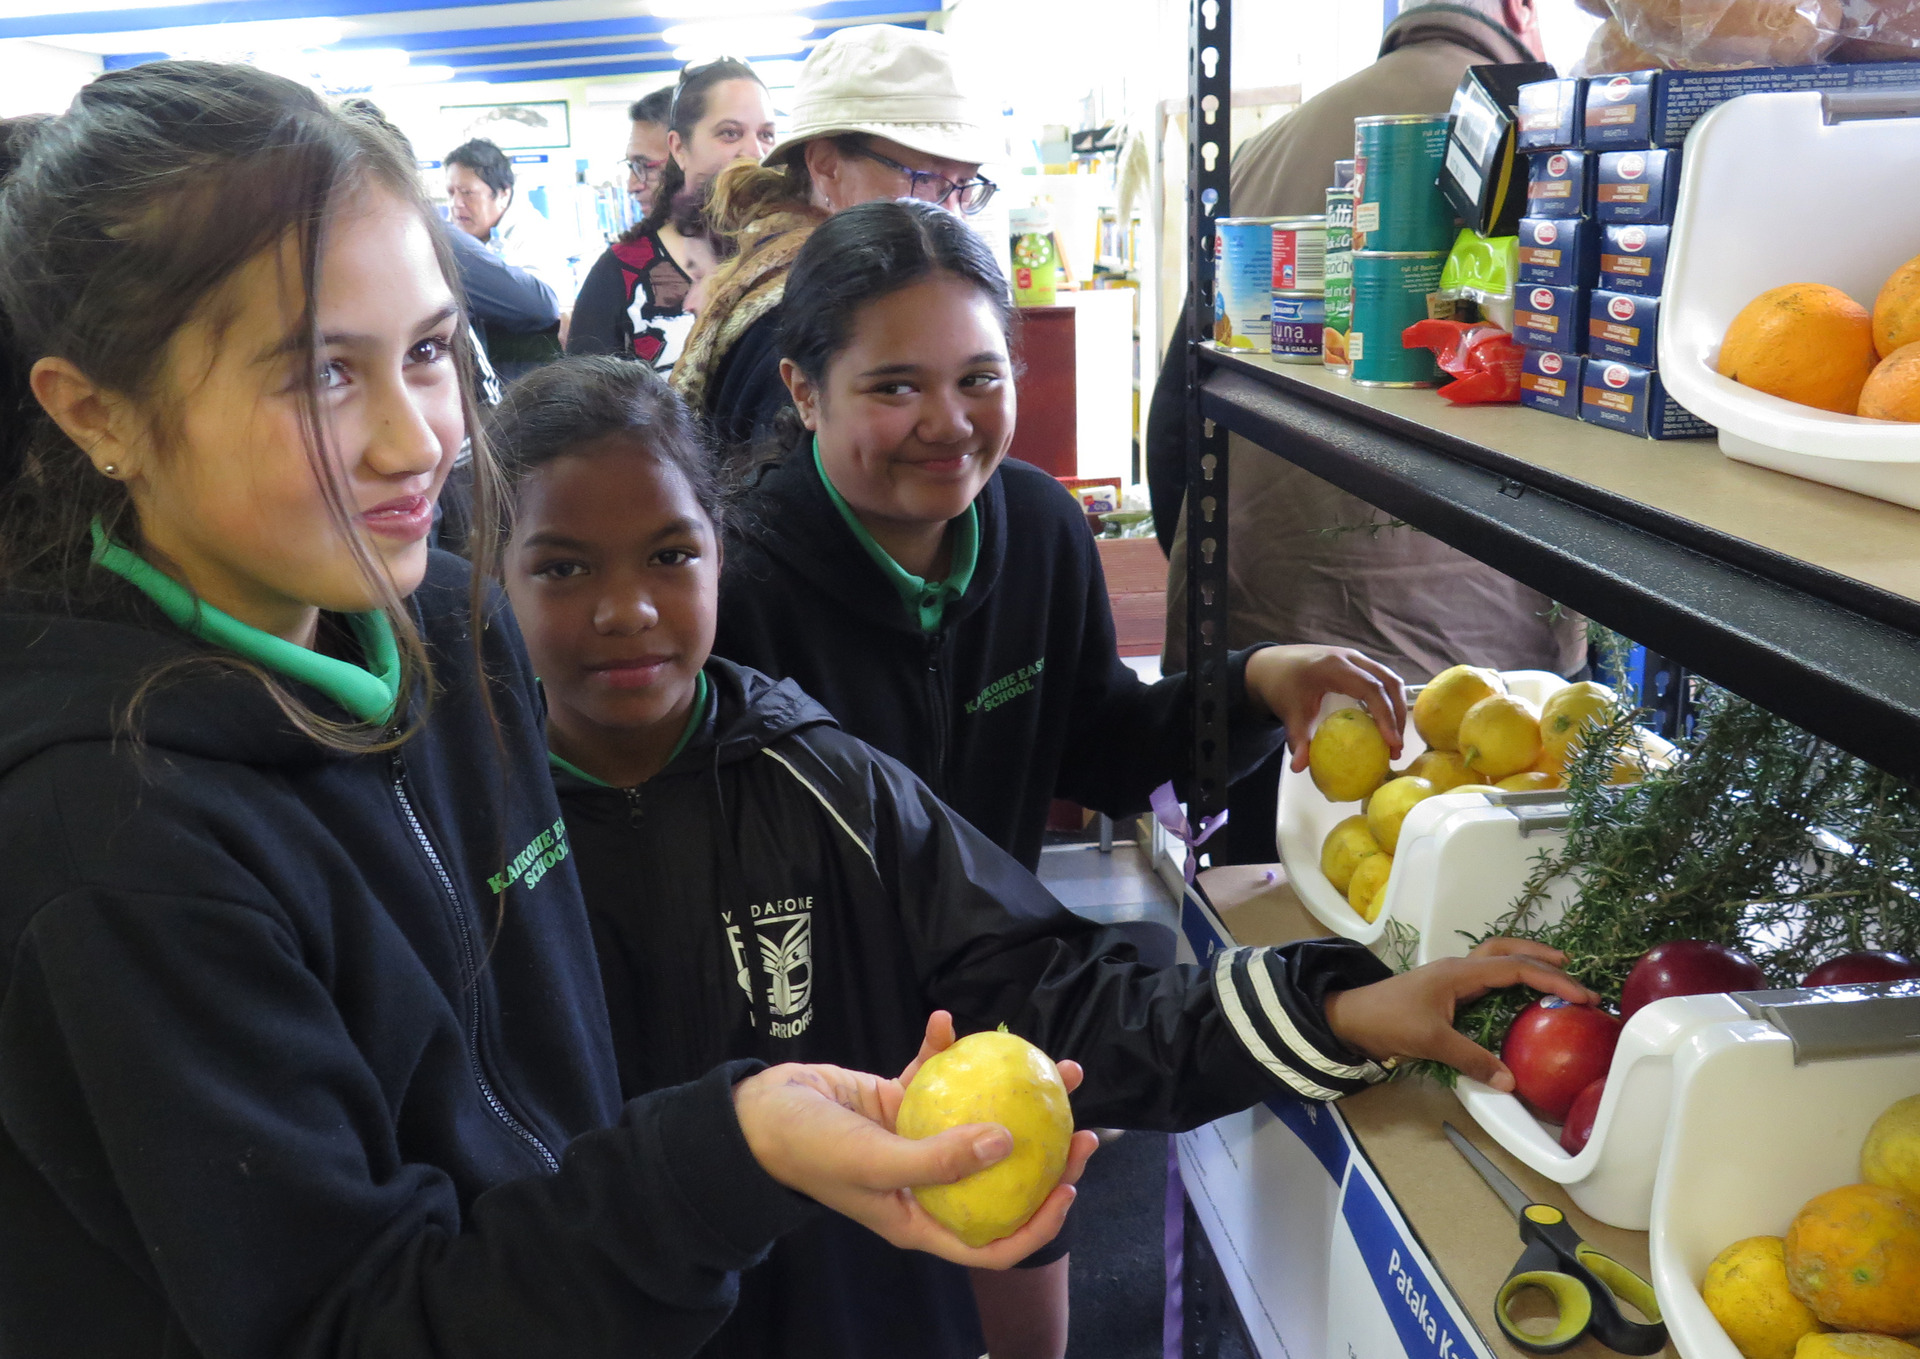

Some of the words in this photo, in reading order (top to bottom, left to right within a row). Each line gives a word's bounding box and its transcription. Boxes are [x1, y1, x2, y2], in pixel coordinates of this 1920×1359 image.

[984, 680, 1034, 712] SCHOOL
[722, 896, 813, 924] VDAFONE
[1388, 1248, 1437, 1344] Pataka
